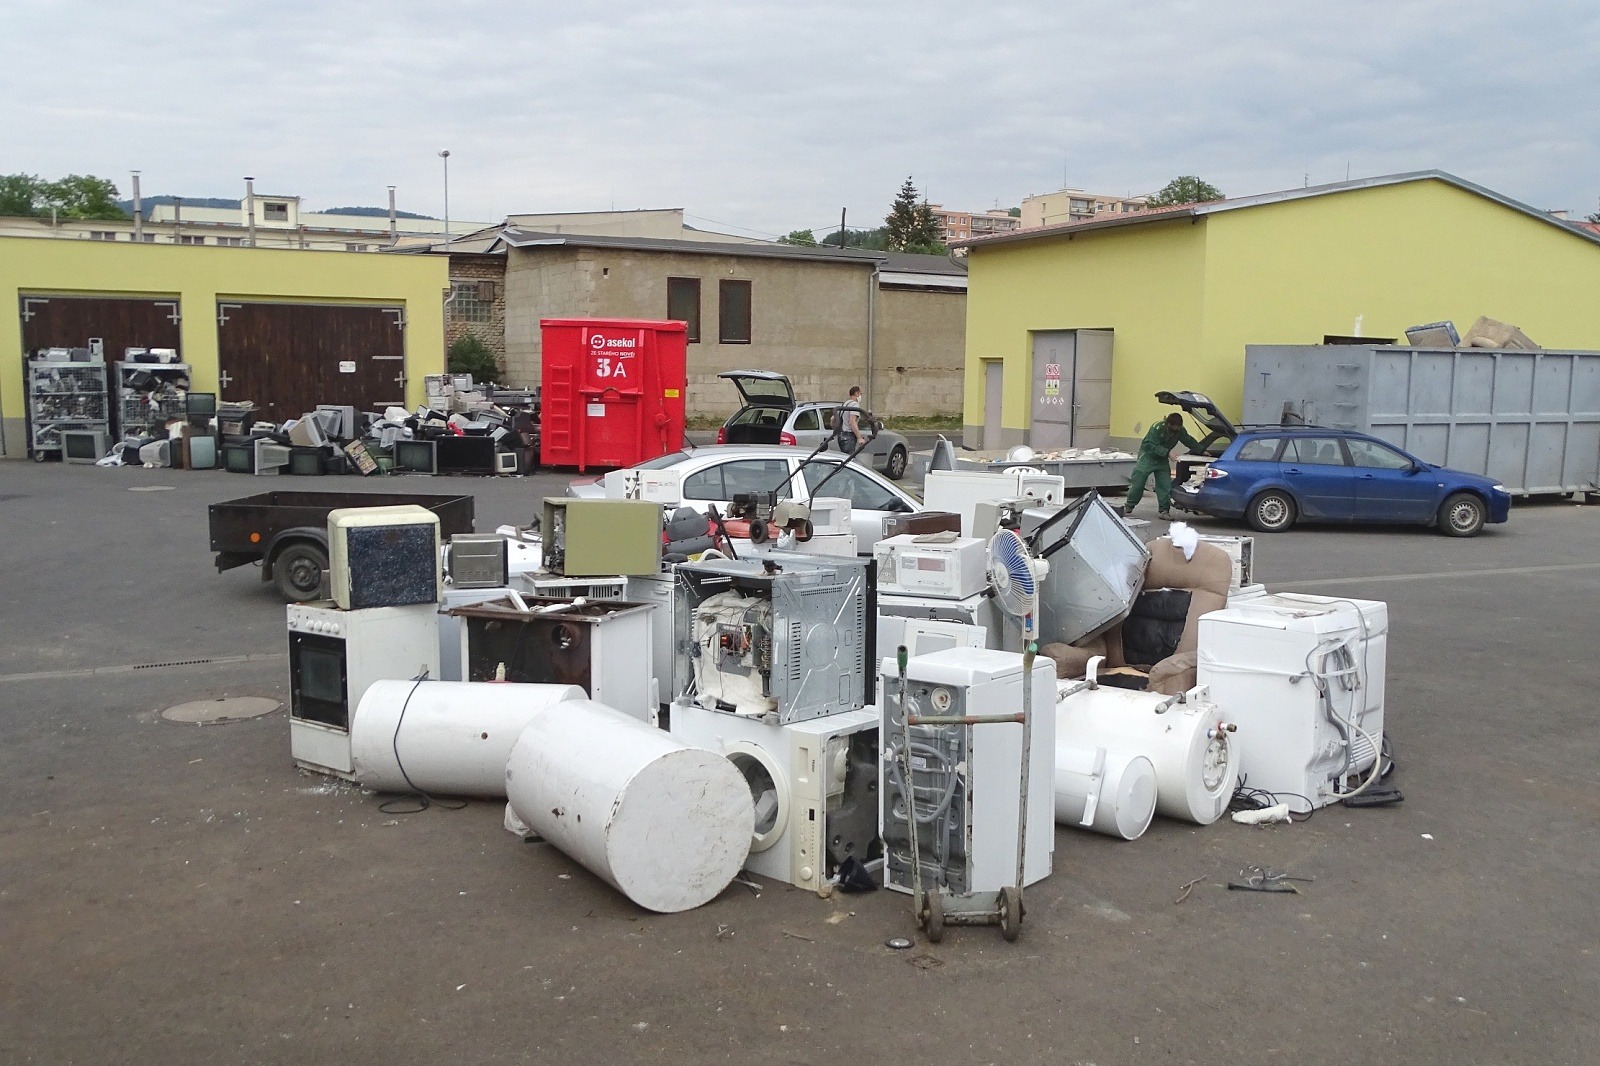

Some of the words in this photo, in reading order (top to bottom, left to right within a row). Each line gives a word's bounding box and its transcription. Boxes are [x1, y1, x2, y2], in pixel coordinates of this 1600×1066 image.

[607, 338, 635, 348] asekol
[596, 358, 611, 377] 3
[613, 362, 627, 377] A
